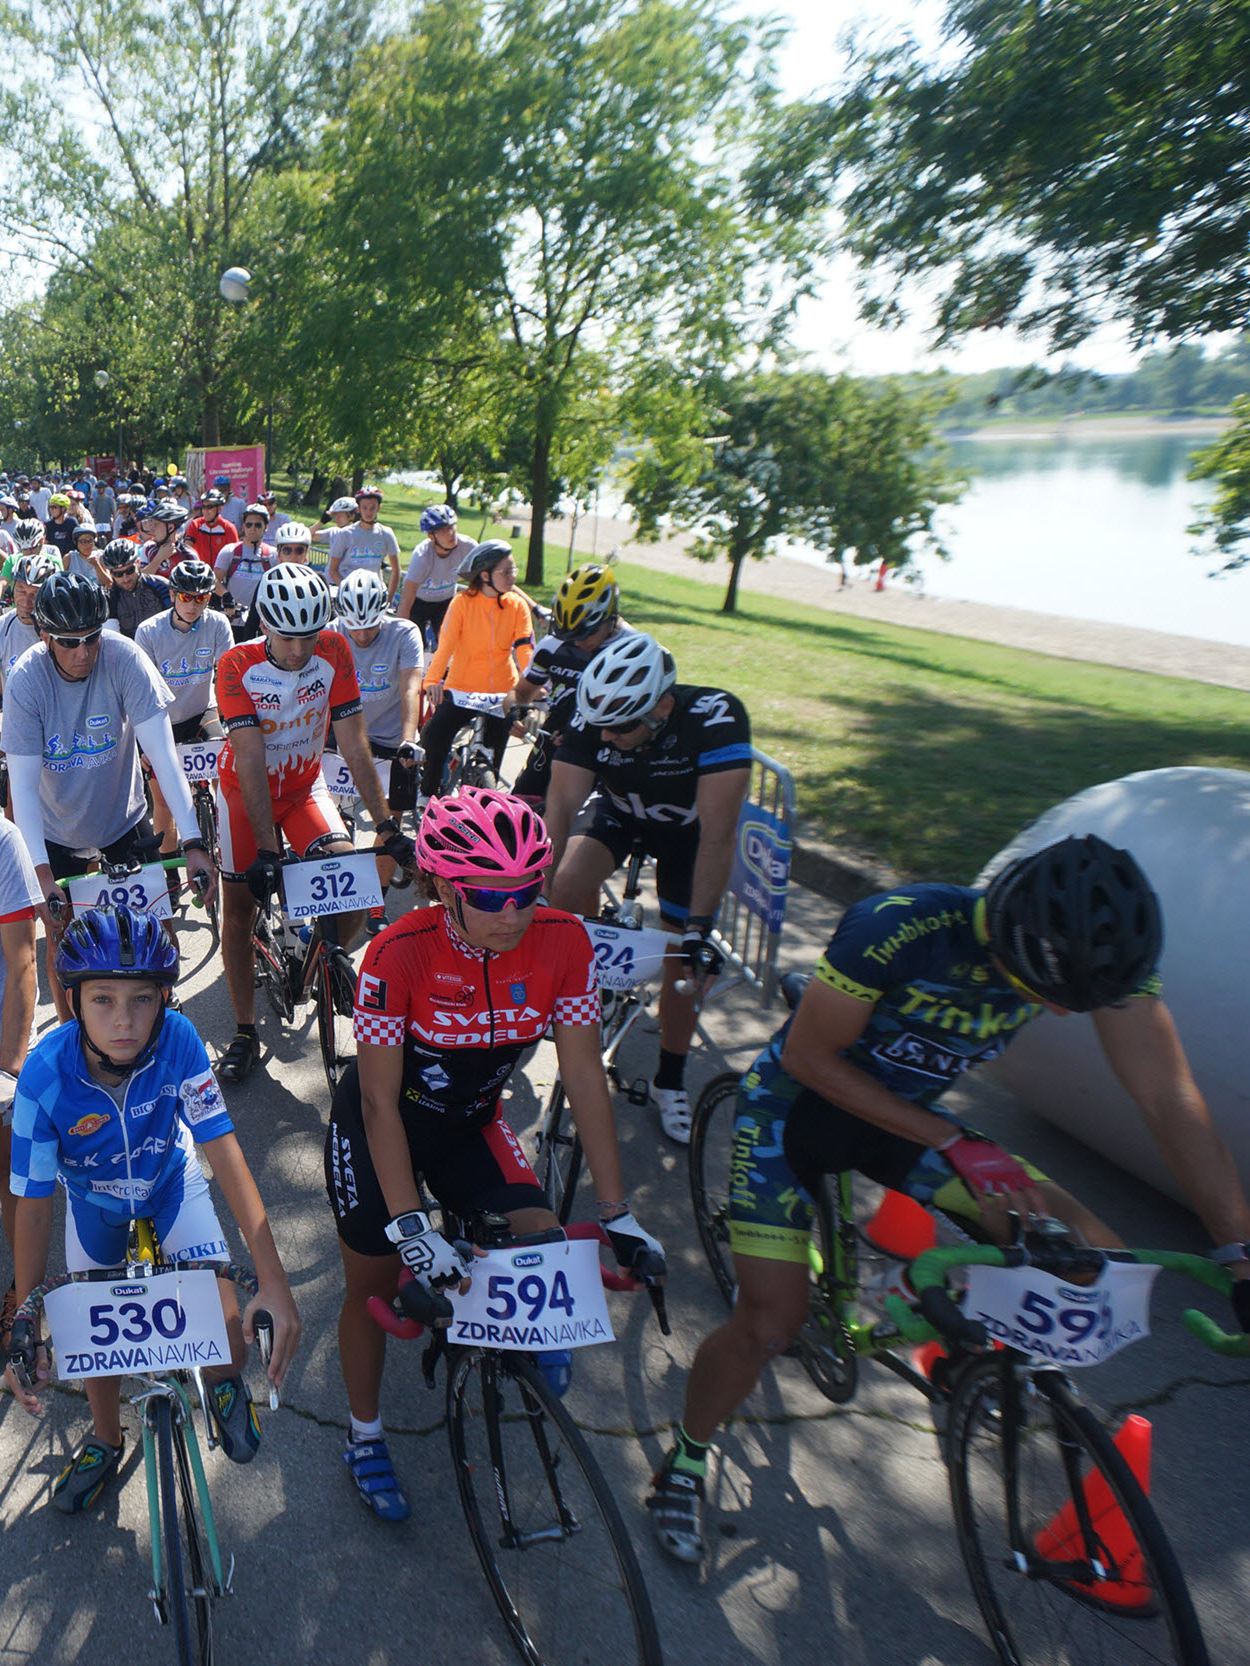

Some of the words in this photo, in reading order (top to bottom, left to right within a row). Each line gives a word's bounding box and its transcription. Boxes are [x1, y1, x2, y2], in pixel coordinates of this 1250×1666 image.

[183, 753, 217, 772] 509
[96, 884, 148, 909] 493
[310, 871, 357, 901] 312
[293, 895, 379, 917] ZDRAVANAVIKA
[433, 1006, 541, 1027] SVETA
[341, 1136, 360, 1210] SVETA
[515, 1255, 542, 1267] Dukat
[114, 1286, 144, 1296] Dukat
[486, 1270, 575, 1322] 594
[89, 1298, 186, 1346] 530
[456, 1318, 607, 1346] ZDRAVANAVIKA
[65, 1340, 222, 1374] ZDRAVANAVIKA
